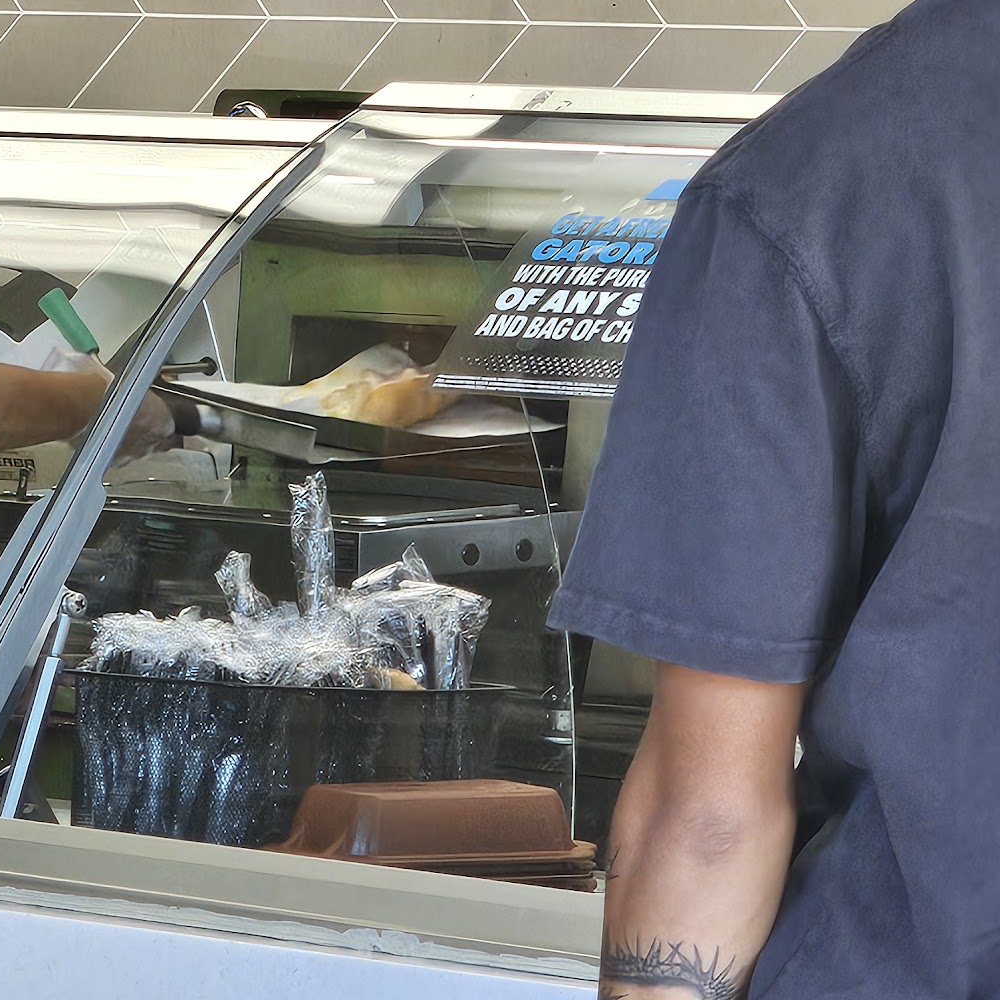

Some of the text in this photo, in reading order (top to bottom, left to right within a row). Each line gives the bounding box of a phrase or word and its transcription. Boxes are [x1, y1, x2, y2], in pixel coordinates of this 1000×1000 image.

[552, 214, 604, 236] GET
[597, 215, 622, 237] A
[512, 264, 566, 284] WITH
[564, 266, 606, 286] THE
[494, 287, 548, 311] OF
[538, 289, 624, 315] ANY
[474, 313, 529, 338] AND
[523, 316, 575, 341] BAG
[570, 318, 607, 342] OF
